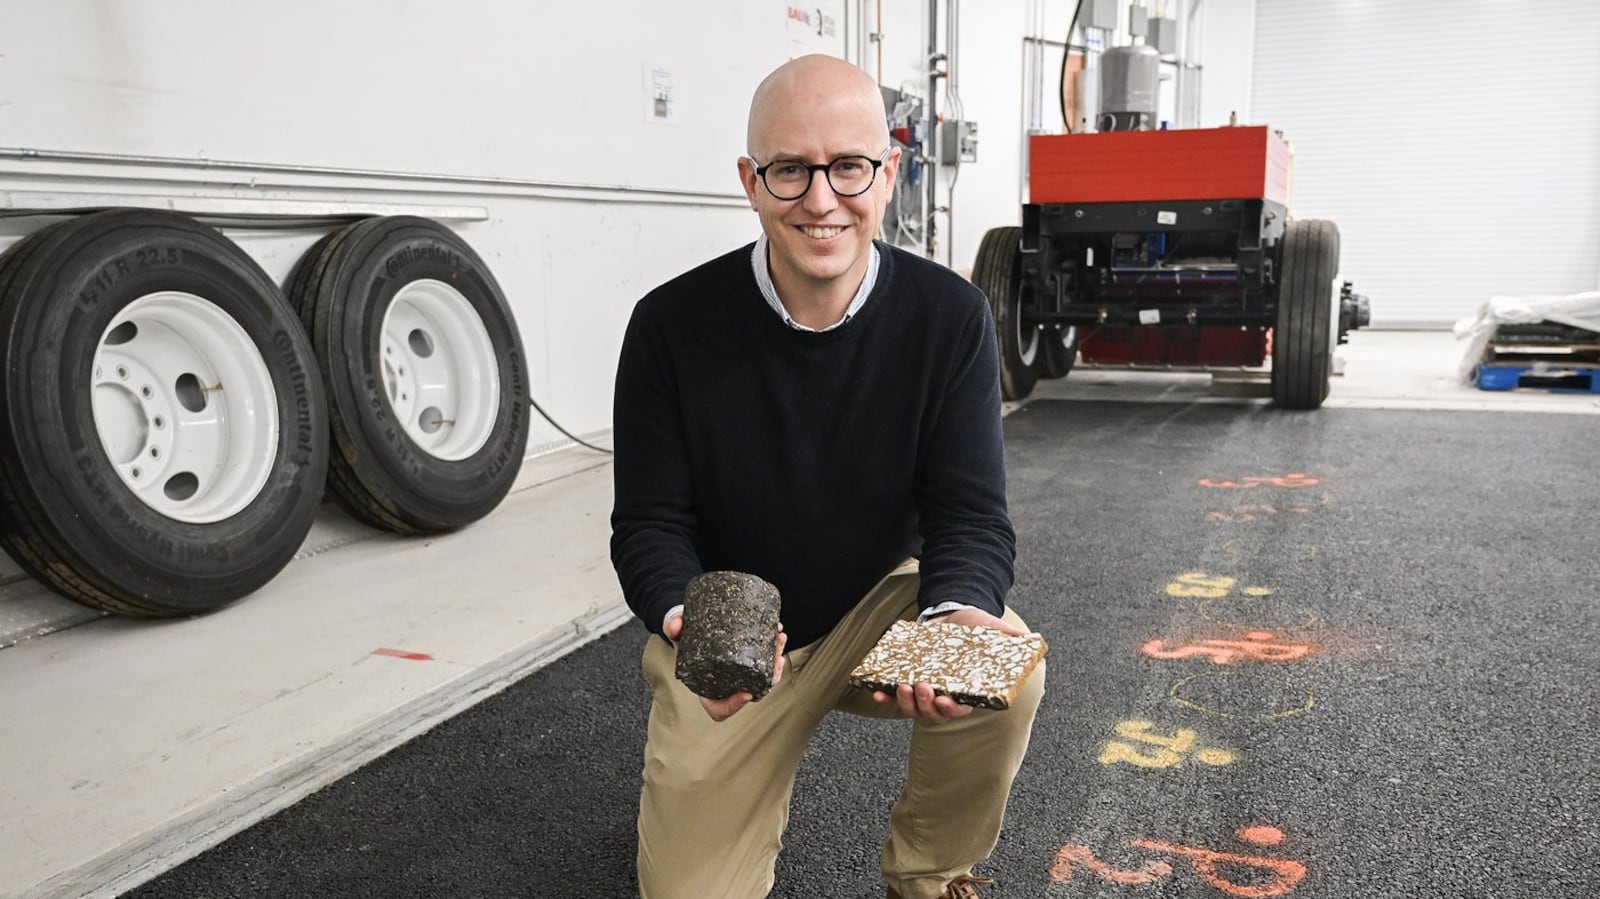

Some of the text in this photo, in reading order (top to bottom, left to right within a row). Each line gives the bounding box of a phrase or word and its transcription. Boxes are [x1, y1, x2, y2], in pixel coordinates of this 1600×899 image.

[135, 247, 178, 266] 22.5
[386, 245, 452, 277] Continental
[273, 330, 312, 452] Continental
[509, 351, 522, 396] Conti
[503, 400, 522, 454] Hybrid
